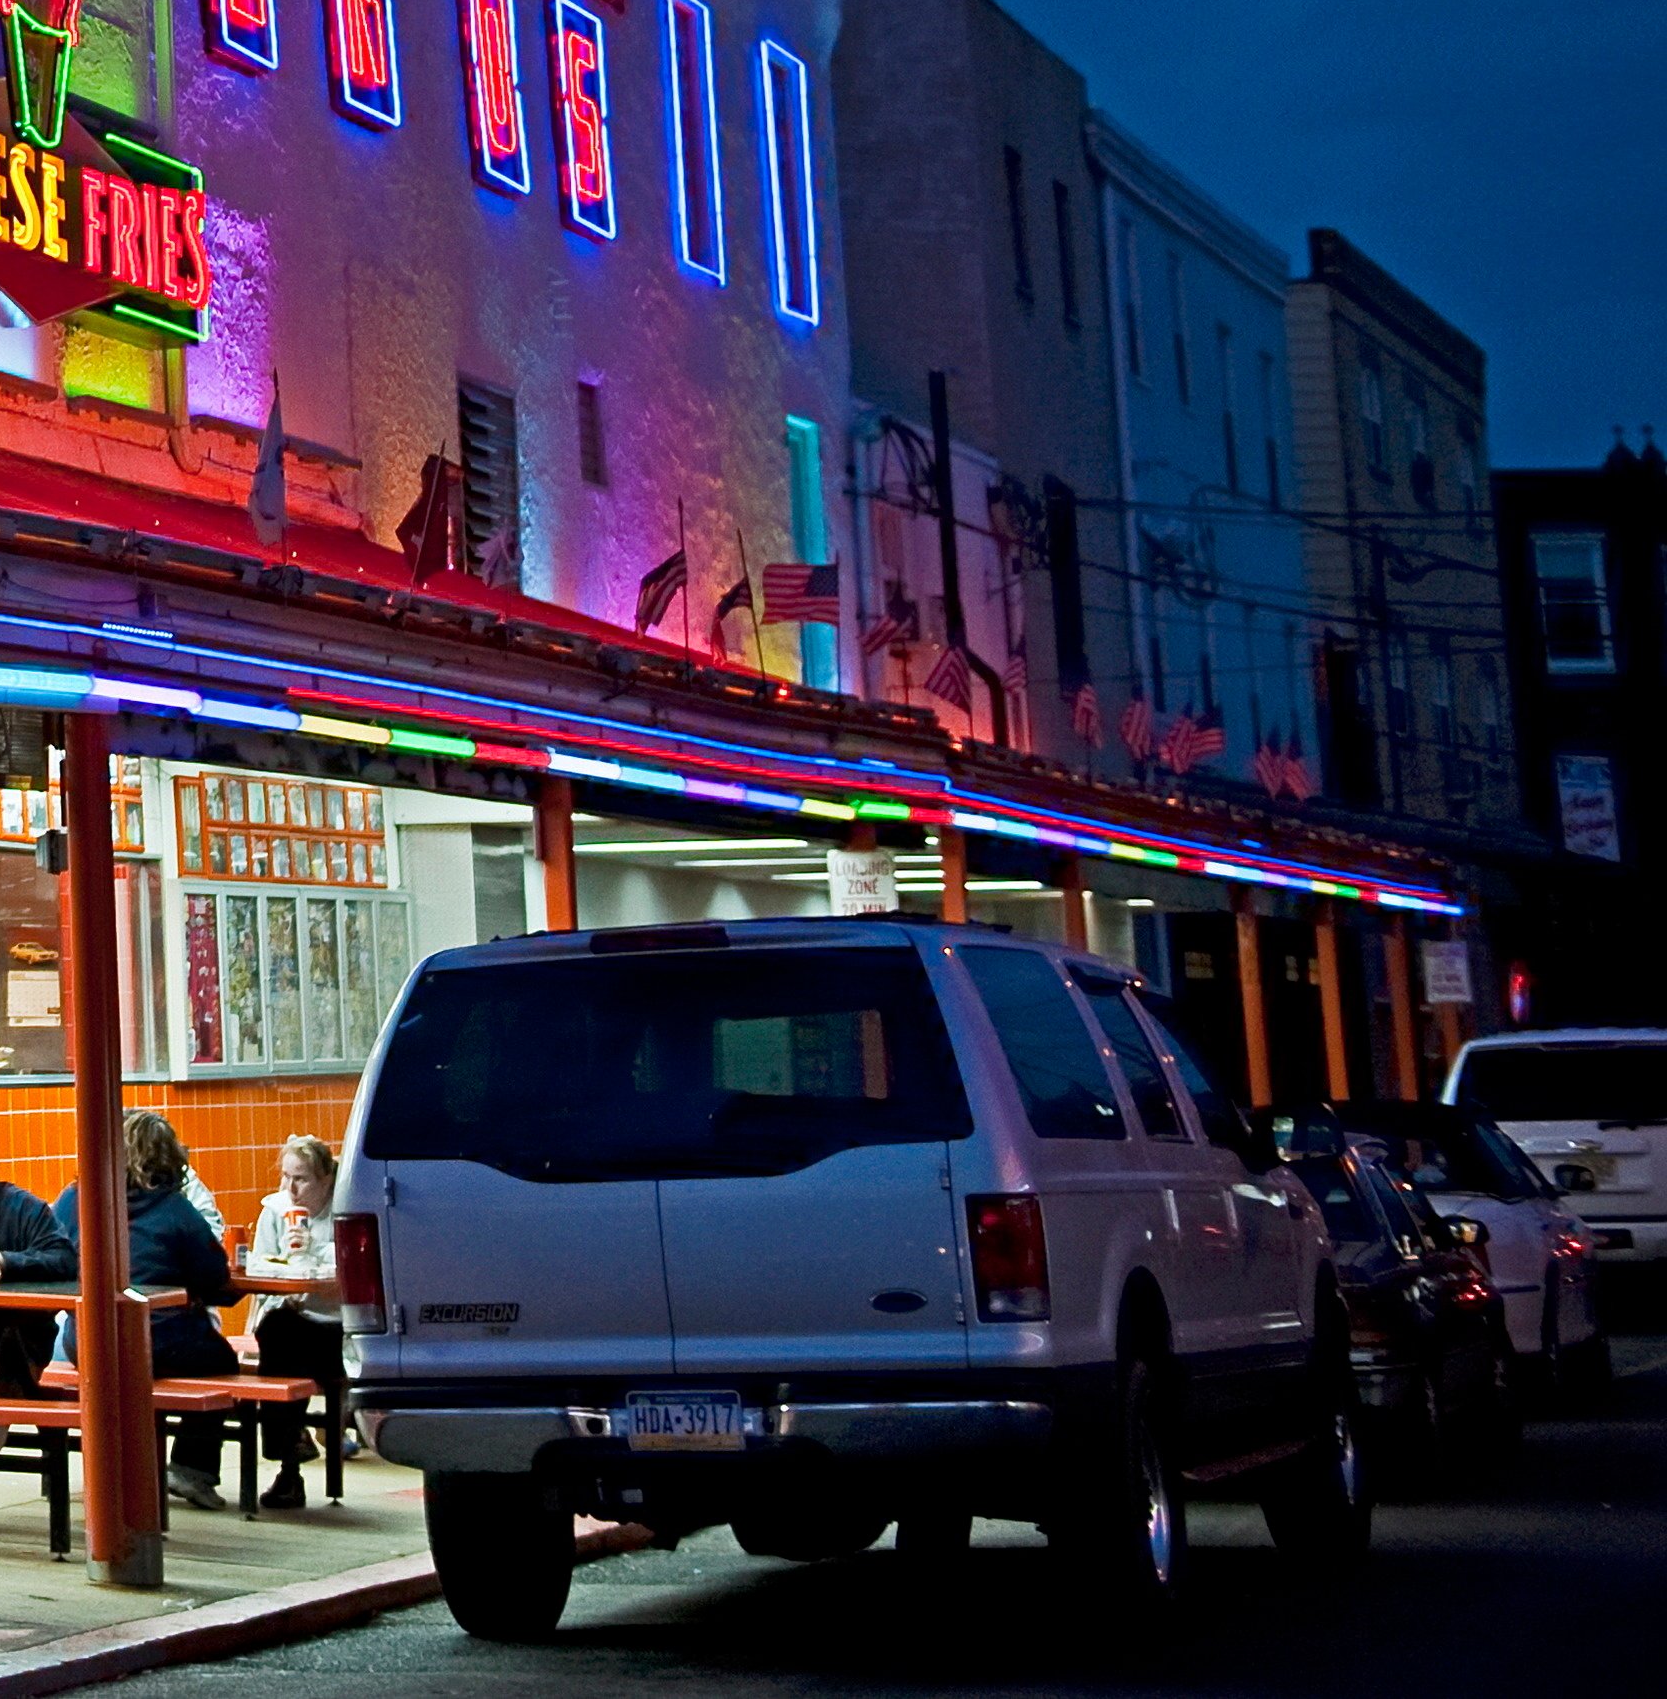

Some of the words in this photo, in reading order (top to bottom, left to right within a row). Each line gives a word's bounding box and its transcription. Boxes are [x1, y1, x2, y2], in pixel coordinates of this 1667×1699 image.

[82, 167, 212, 310] FRIES
[847, 877, 879, 894] ZONE
[419, 1302, 519, 1322] EXCURSION
